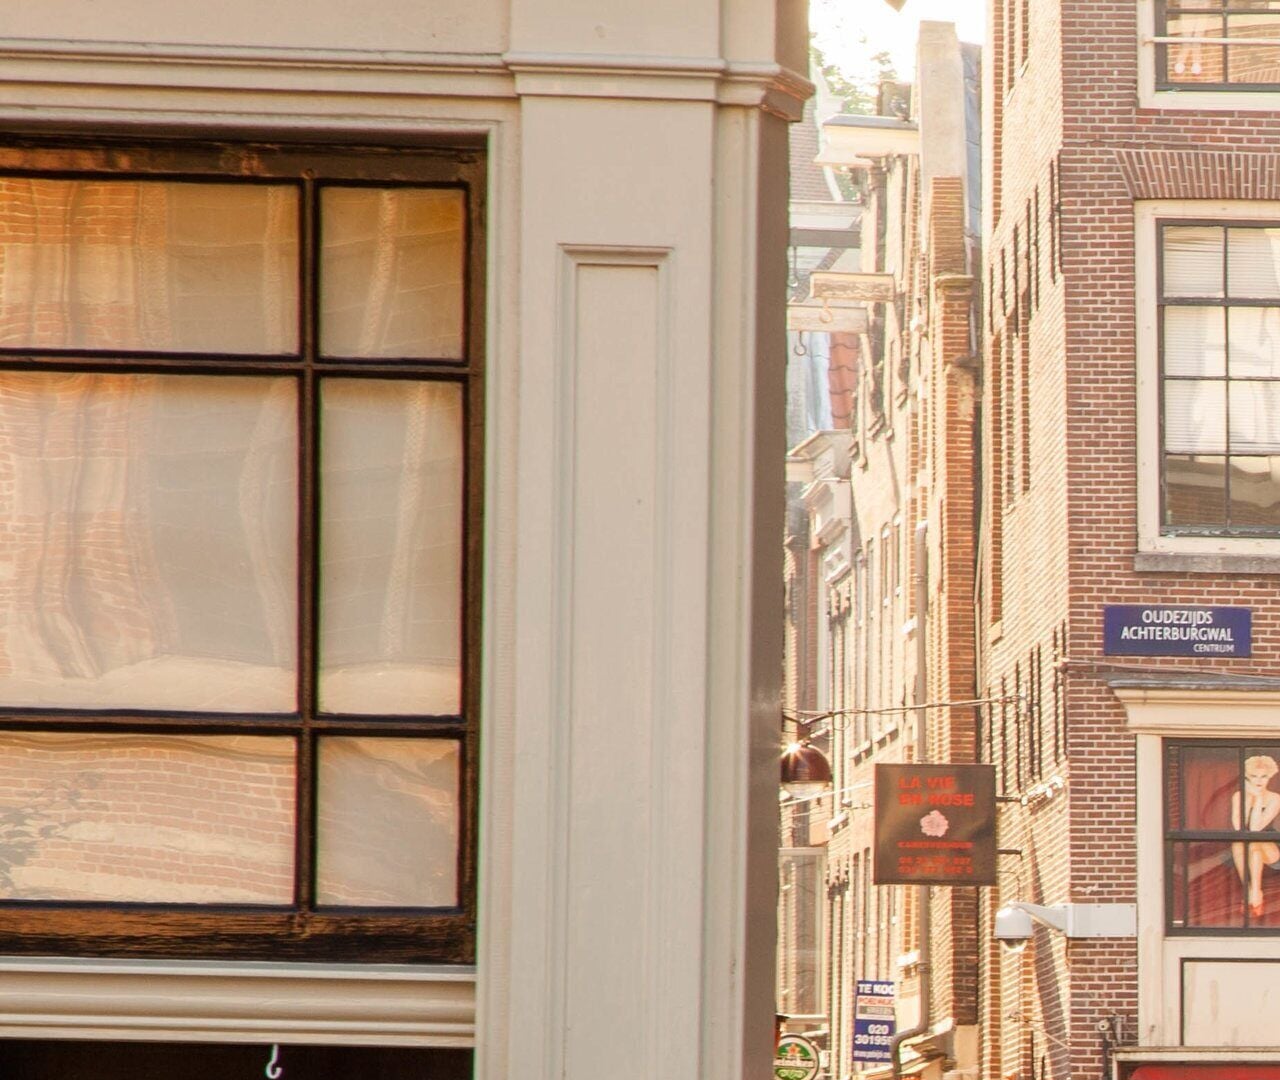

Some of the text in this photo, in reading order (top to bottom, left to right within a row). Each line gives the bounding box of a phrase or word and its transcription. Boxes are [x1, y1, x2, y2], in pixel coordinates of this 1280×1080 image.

[1141, 610, 1213, 626] OUDEZIJDS
[1121, 626, 1234, 642] ACHTERBURGWAL
[1193, 643, 1235, 653] CENTRUM
[928, 793, 975, 806] ROSE
[858, 983, 872, 994] TE
[868, 1024, 890, 1035] 020
